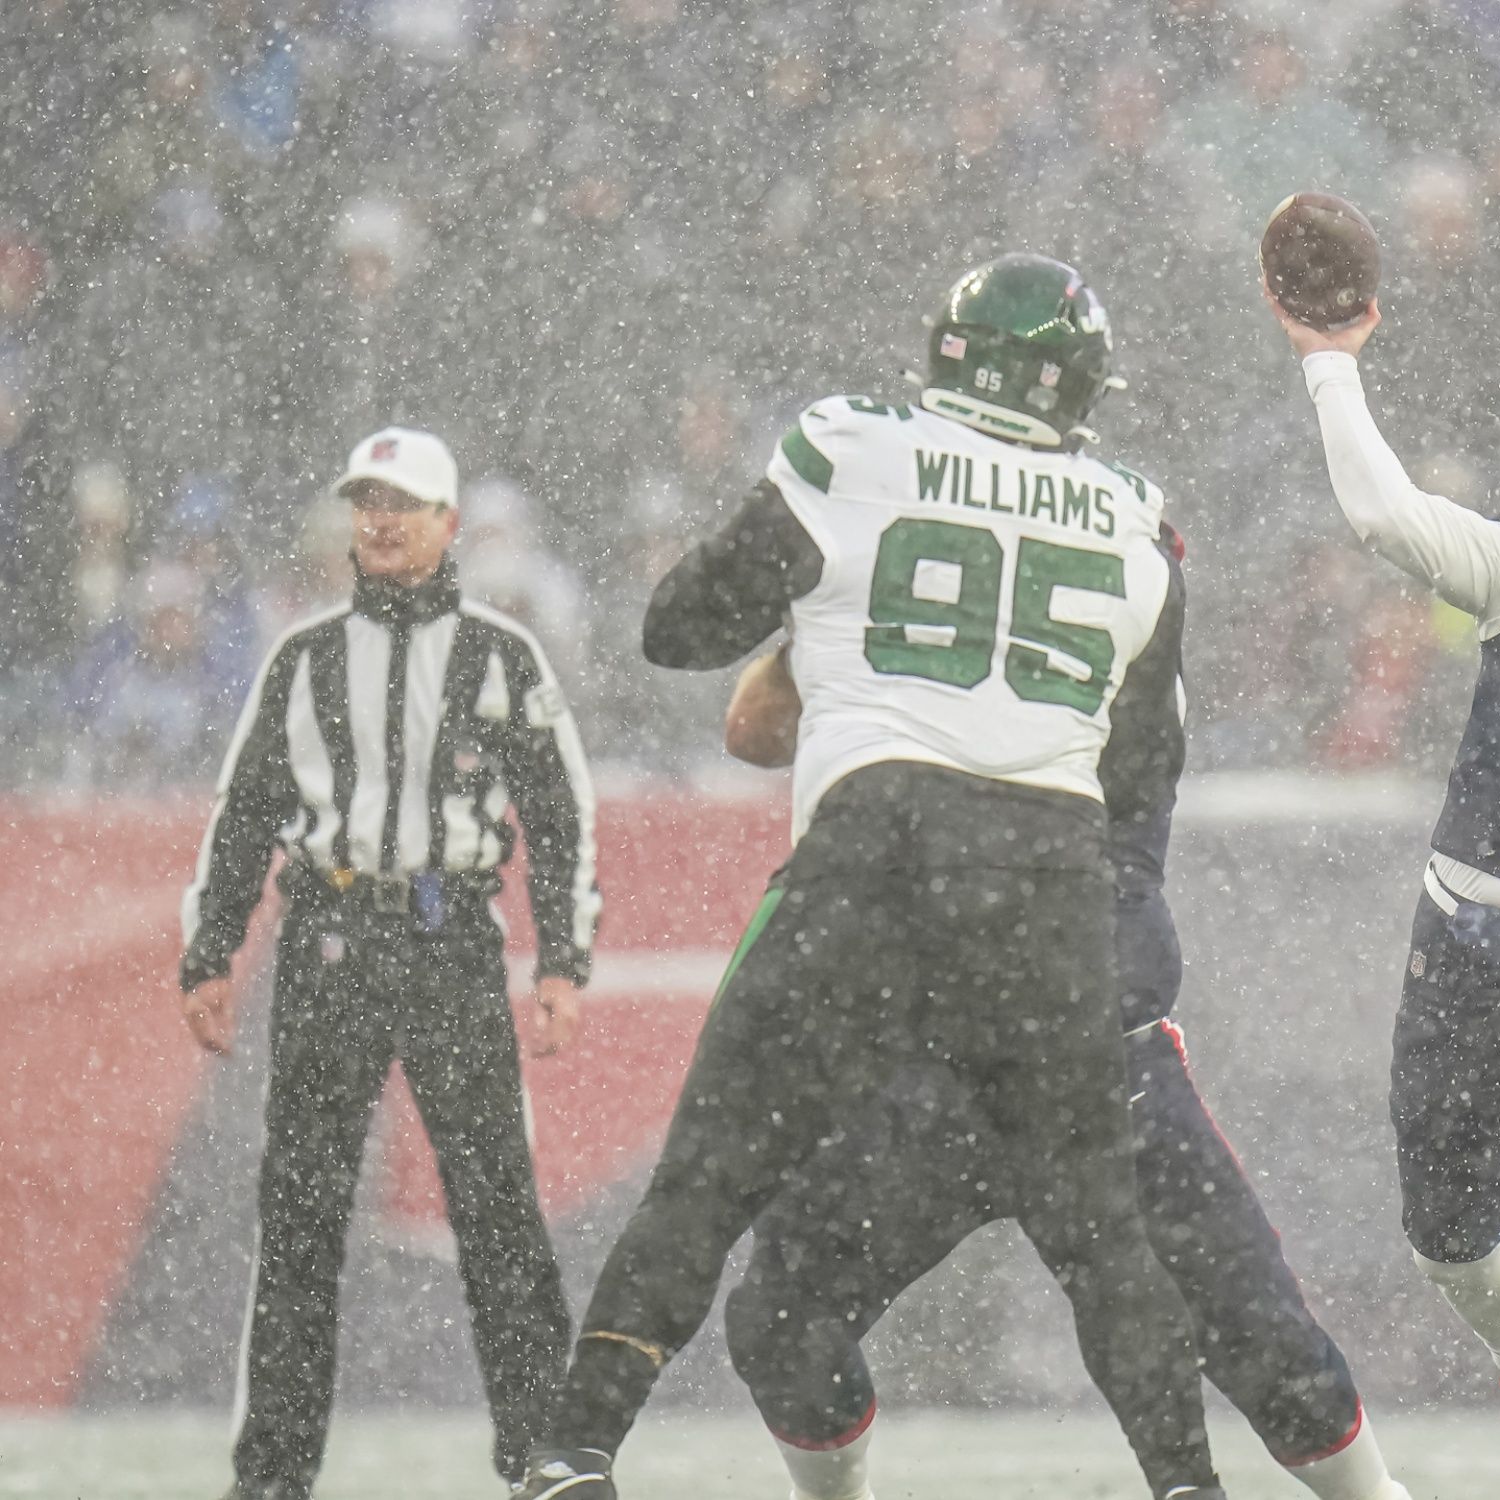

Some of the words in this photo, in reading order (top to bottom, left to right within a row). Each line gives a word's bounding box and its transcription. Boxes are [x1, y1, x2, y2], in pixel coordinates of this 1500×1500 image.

[974, 367, 1002, 392] 95
[915, 449, 1114, 537] WILLIAMS
[864, 516, 1126, 717] 95
